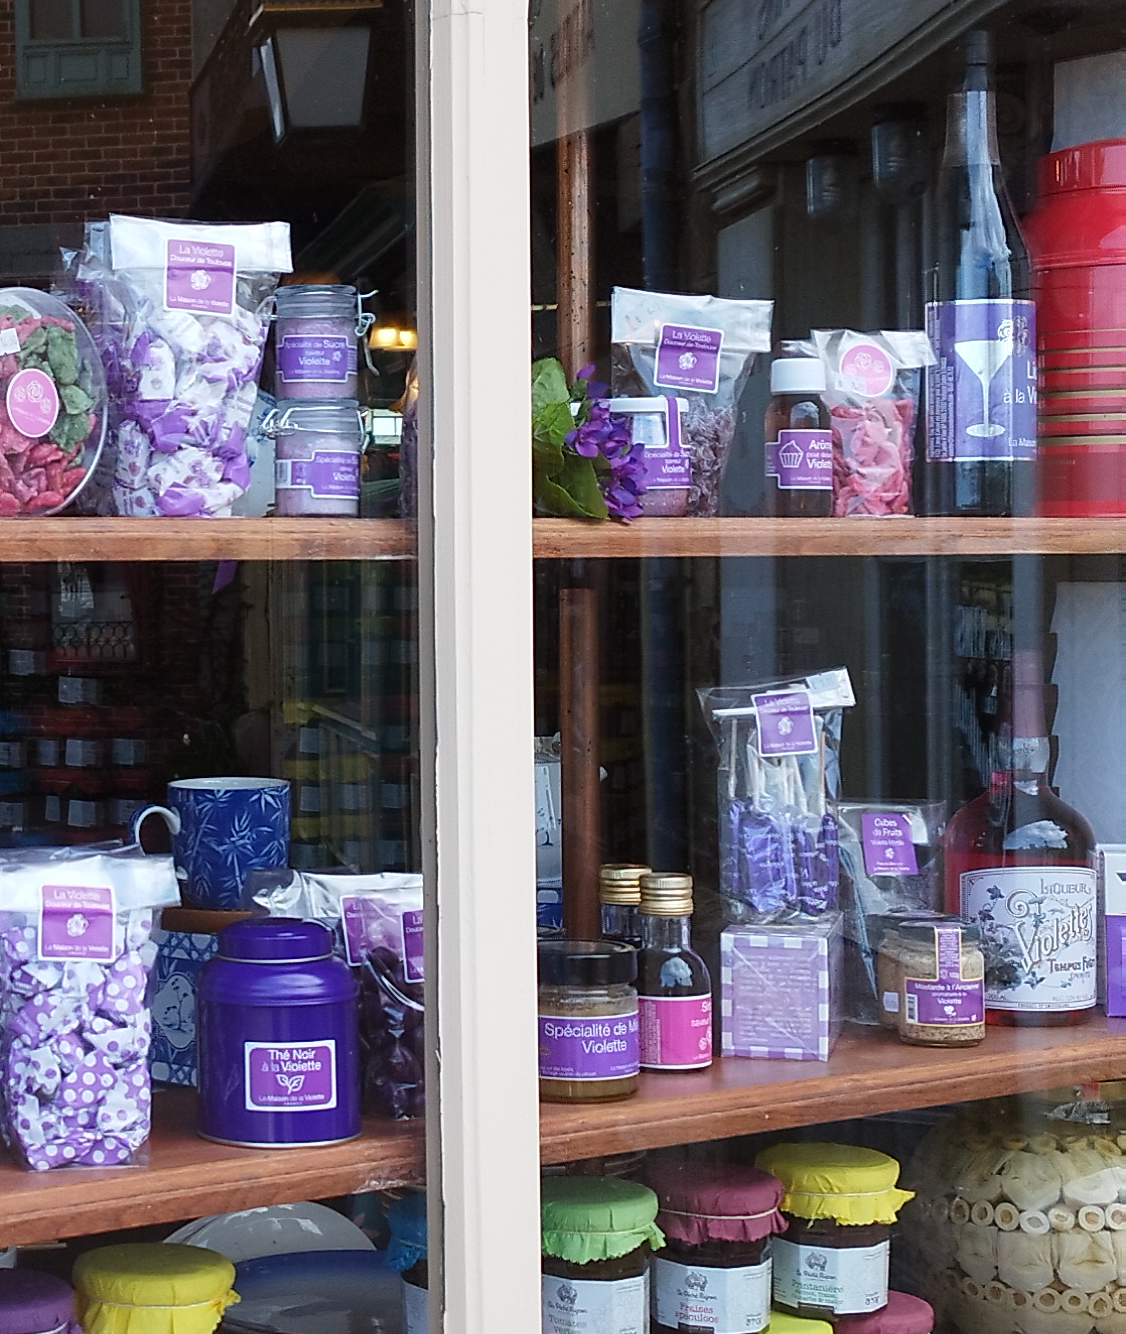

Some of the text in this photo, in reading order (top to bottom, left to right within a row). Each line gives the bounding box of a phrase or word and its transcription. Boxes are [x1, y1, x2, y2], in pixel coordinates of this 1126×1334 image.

[545, 1022, 628, 1040] Spécialité de
[582, 1039, 628, 1054] Violette
[268, 1049, 317, 1061] Thé Noir
[280, 1060, 322, 1073] Violette
